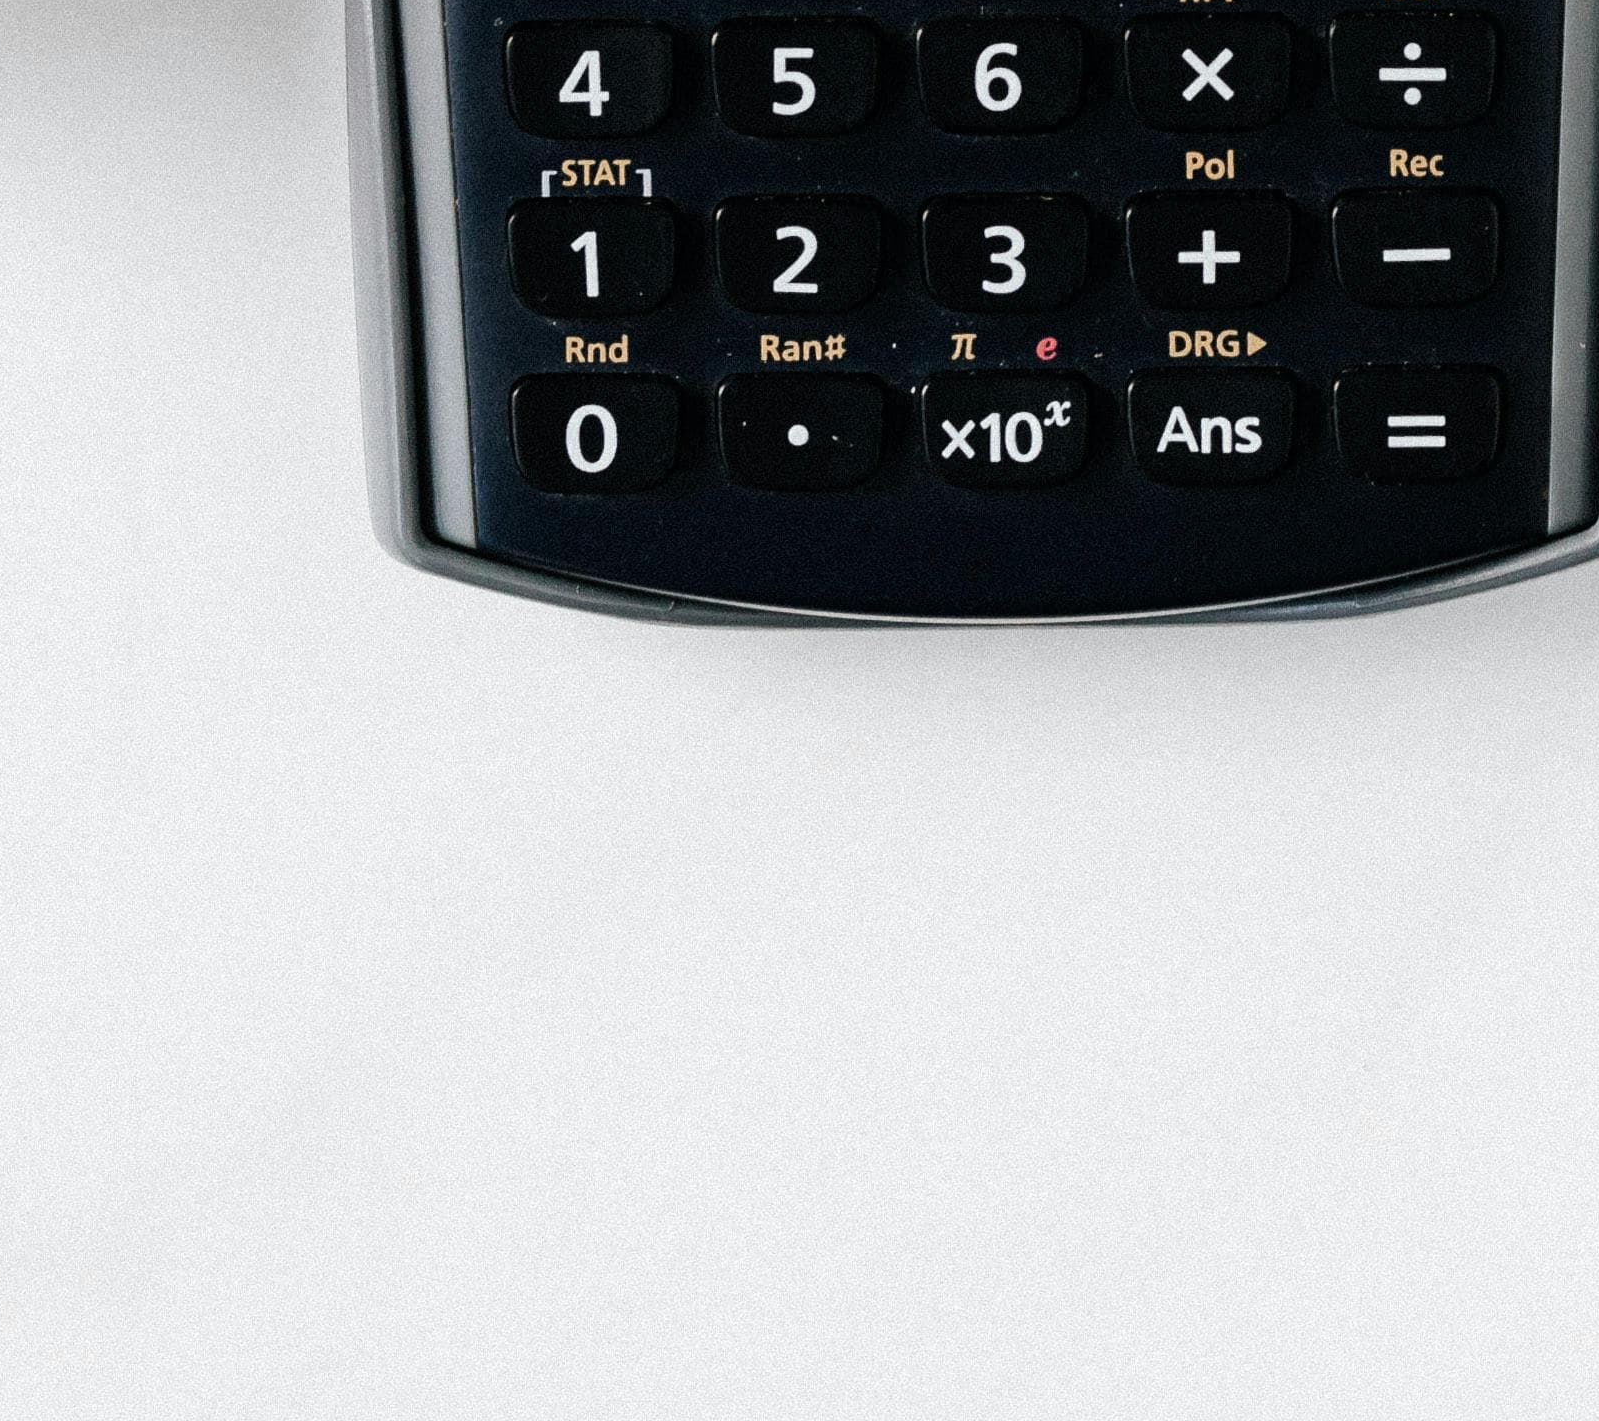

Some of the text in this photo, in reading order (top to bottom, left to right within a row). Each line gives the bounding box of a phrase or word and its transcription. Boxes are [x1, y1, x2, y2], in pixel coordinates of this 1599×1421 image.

[559, 51, 609, 116] 4
[773, 48, 815, 115] 5
[975, 43, 1021, 111] 6
[562, 160, 630, 186] STAT
[1186, 150, 1234, 180] Pol
[1390, 149, 1443, 177] Rec
[571, 231, 599, 297] 1
[773, 226, 818, 293] 2
[982, 226, 1026, 294] 3
[566, 335, 628, 363] Rnd
[761, 335, 845, 361] Ran#
[1036, 337, 1057, 360] e
[566, 405, 617, 472] 0
[1157, 406, 1262, 453] Ans
